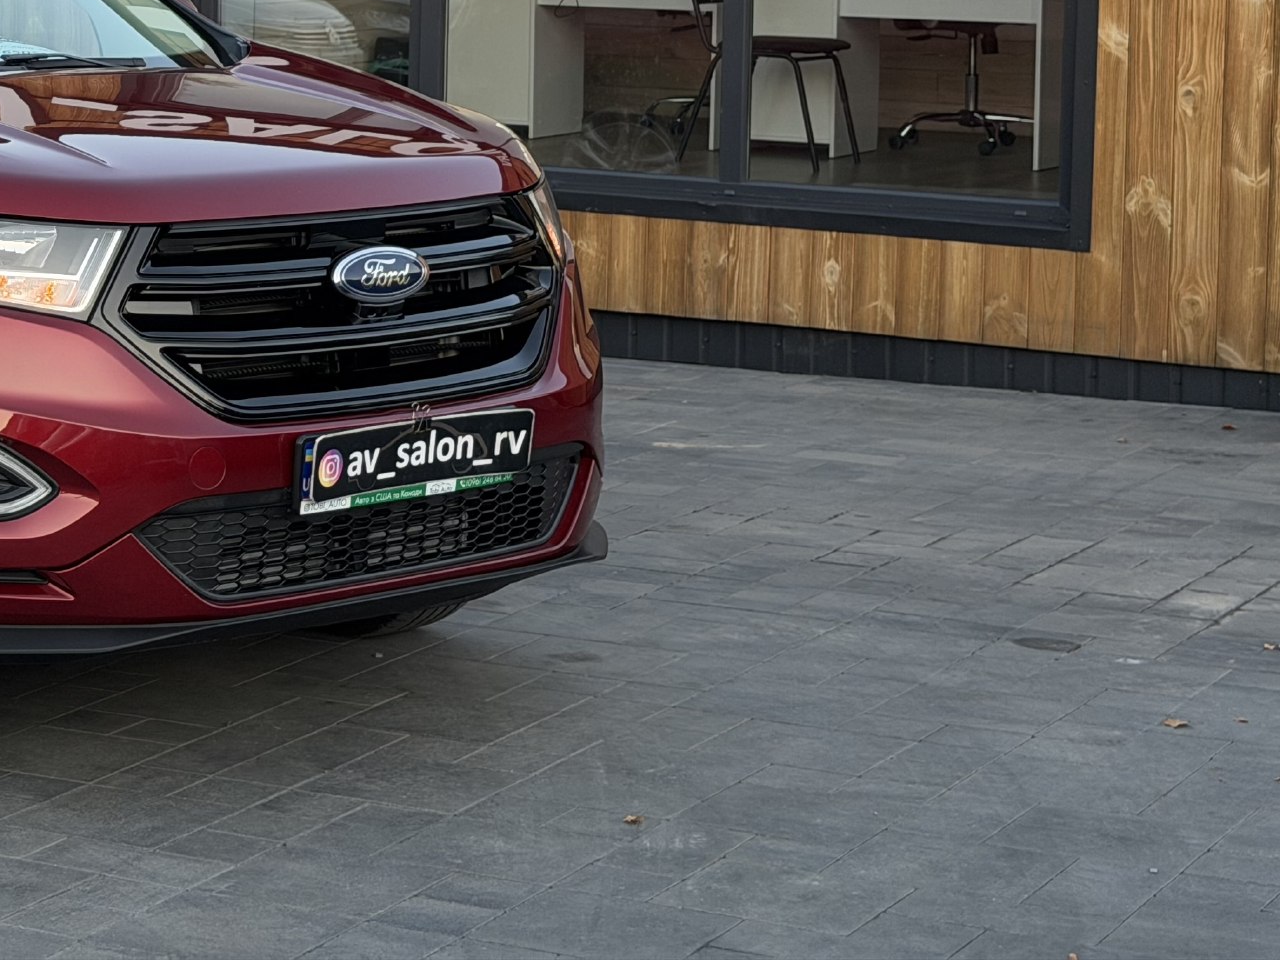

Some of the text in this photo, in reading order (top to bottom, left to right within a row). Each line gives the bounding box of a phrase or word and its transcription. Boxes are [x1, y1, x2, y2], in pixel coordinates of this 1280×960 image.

[361, 257, 411, 288] Ford
[347, 429, 527, 480] av_salon_rv
[375, 492, 392, 502] США
